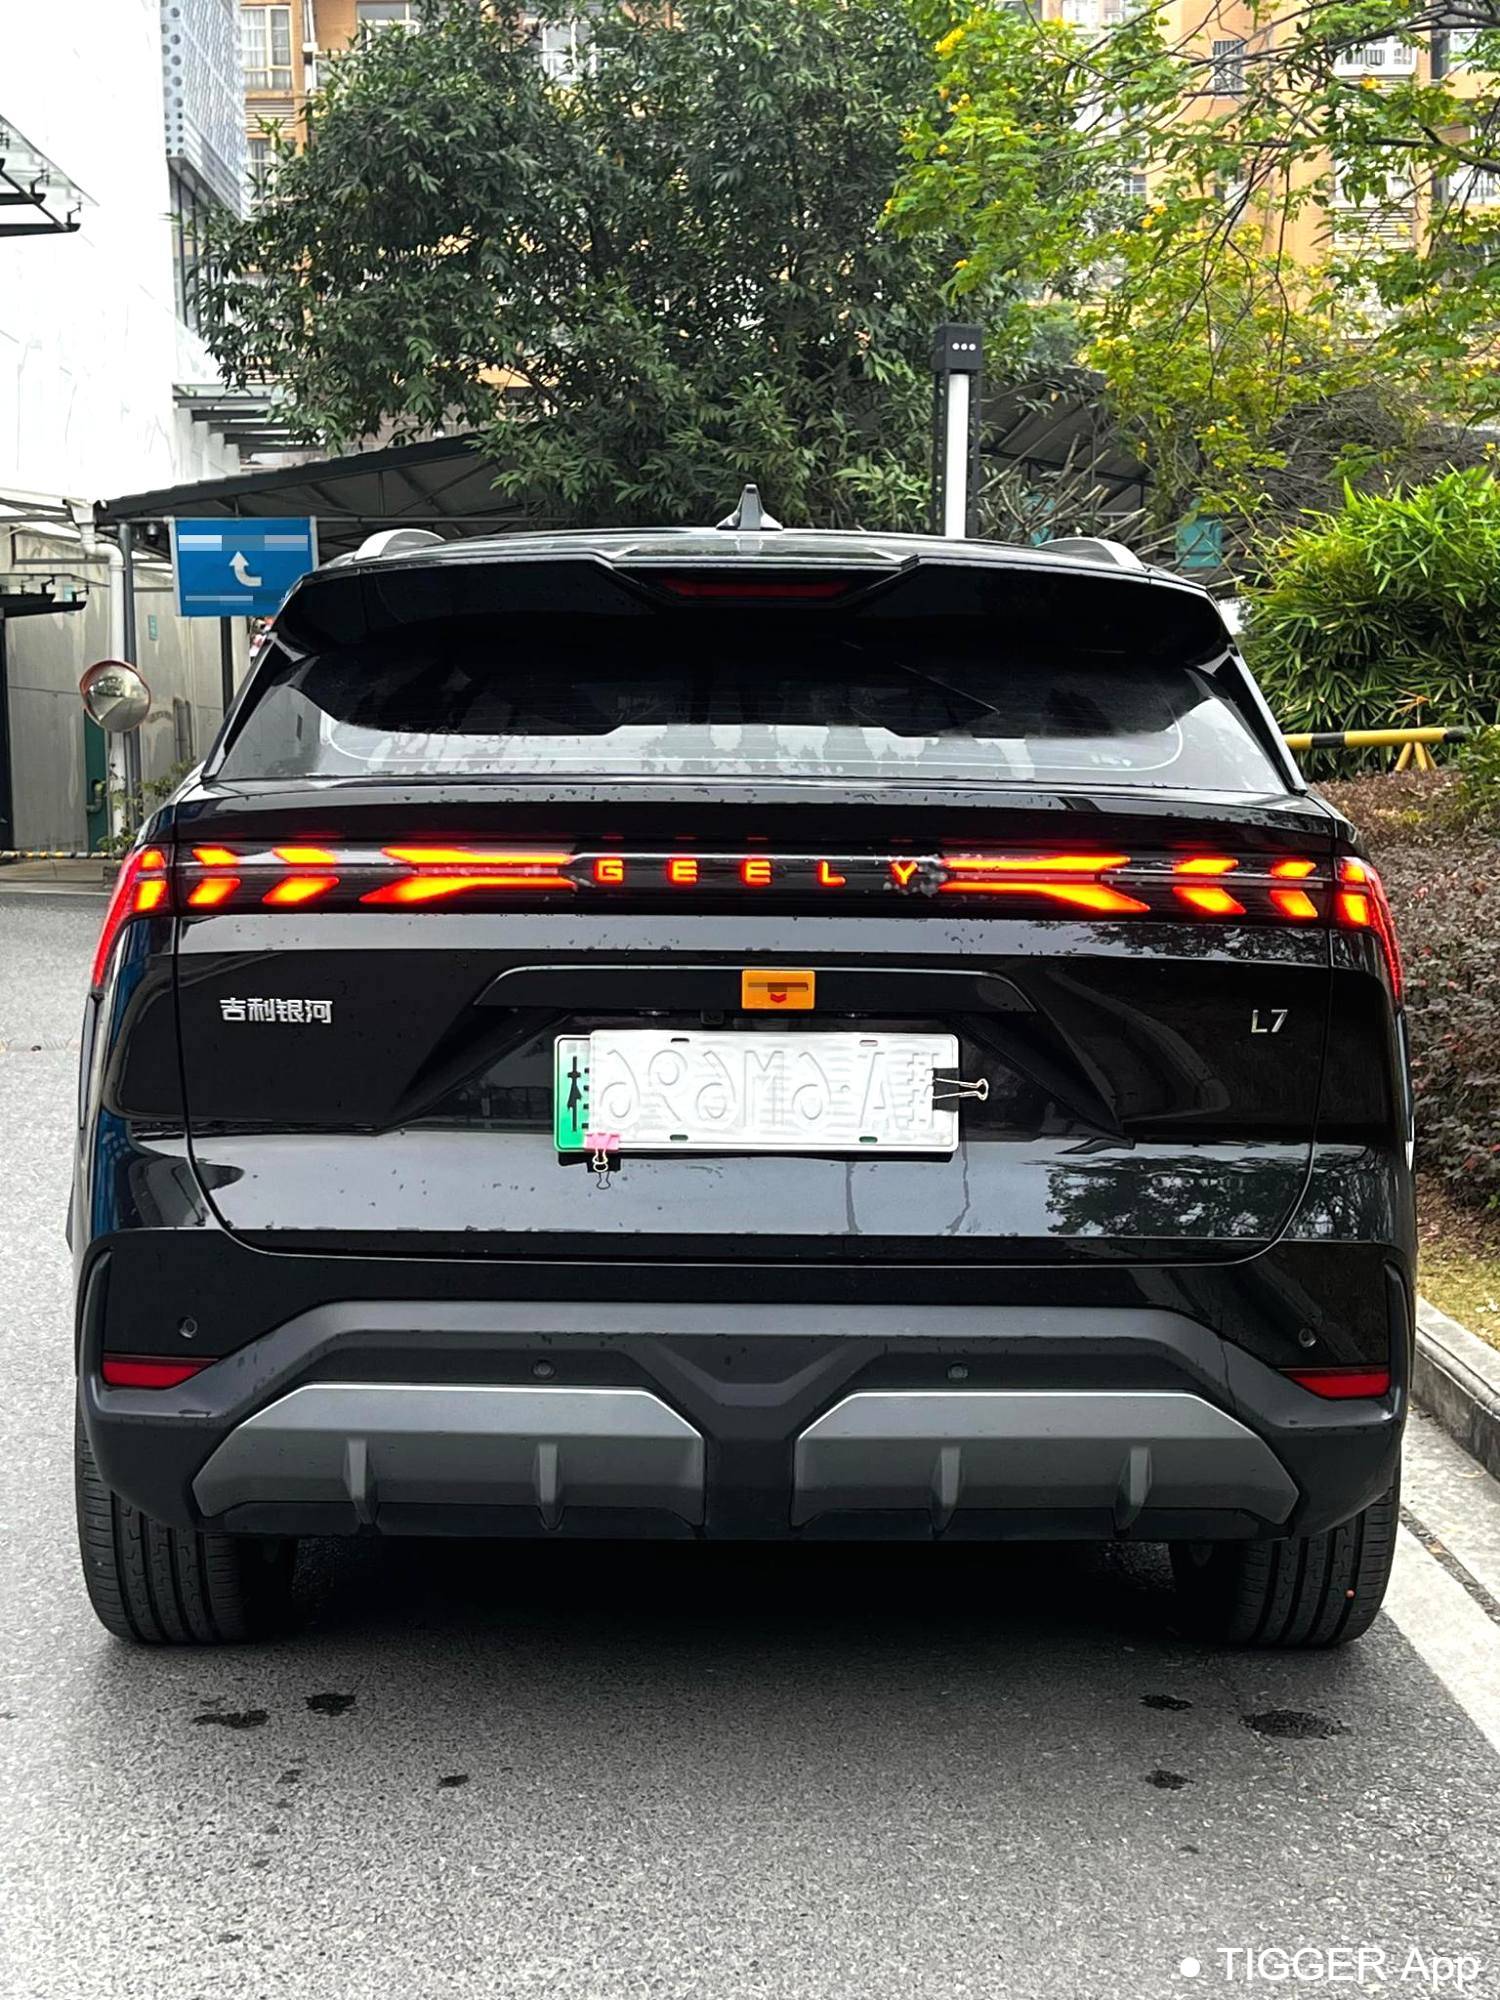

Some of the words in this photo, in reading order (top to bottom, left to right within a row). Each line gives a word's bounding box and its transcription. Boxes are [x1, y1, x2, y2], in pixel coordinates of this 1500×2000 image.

[594, 858, 918, 886] GEELY
[219, 997, 333, 1023] 吉利银河
[1251, 1008, 1288, 1033] L7
